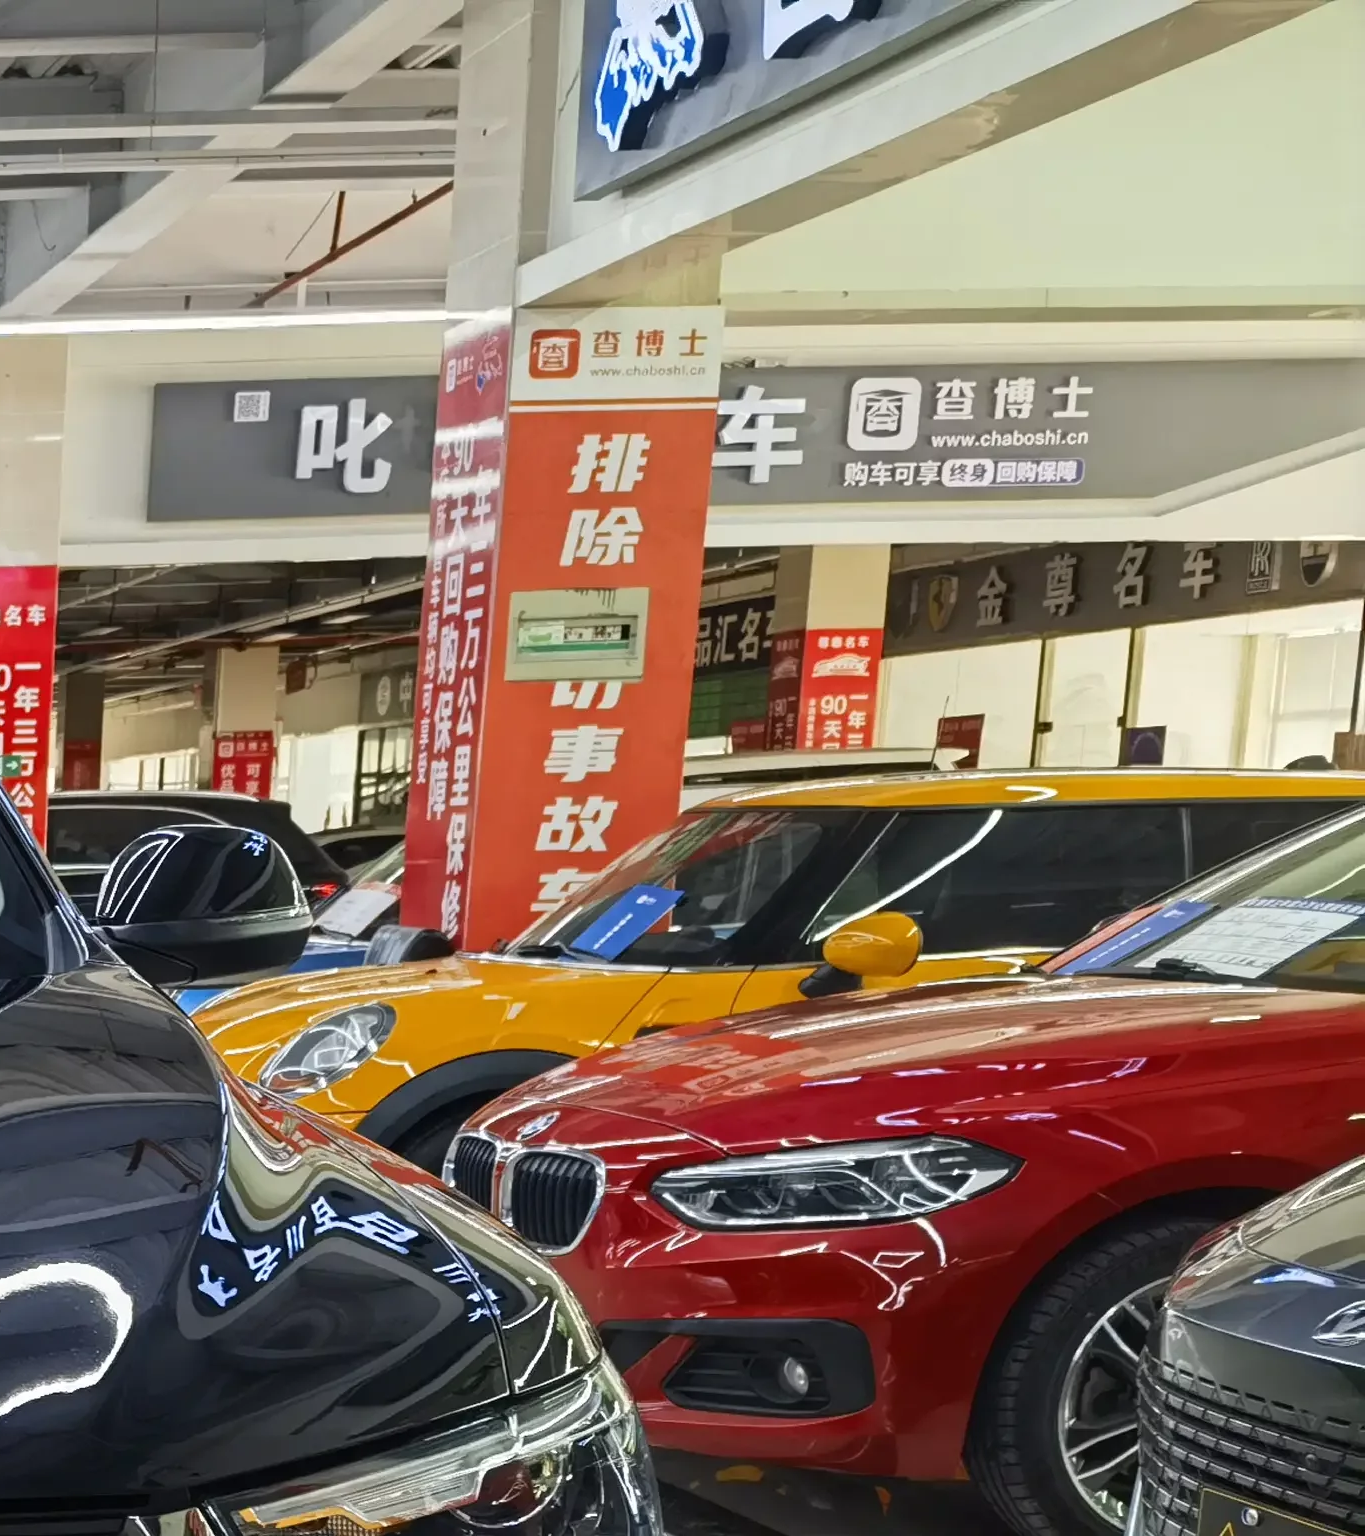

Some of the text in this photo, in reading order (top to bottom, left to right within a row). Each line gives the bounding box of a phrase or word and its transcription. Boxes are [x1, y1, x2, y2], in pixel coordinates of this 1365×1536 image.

[591, 328, 708, 358] 查博士
[590, 365, 706, 378] www.chaboshi.cn
[933, 375, 1093, 420] 查博士
[295, 397, 393, 494] 叱
[712, 384, 805, 486] 车
[931, 428, 1089, 448] www.chaboshi.cn
[976, 542, 1217, 628] 金尊名车
